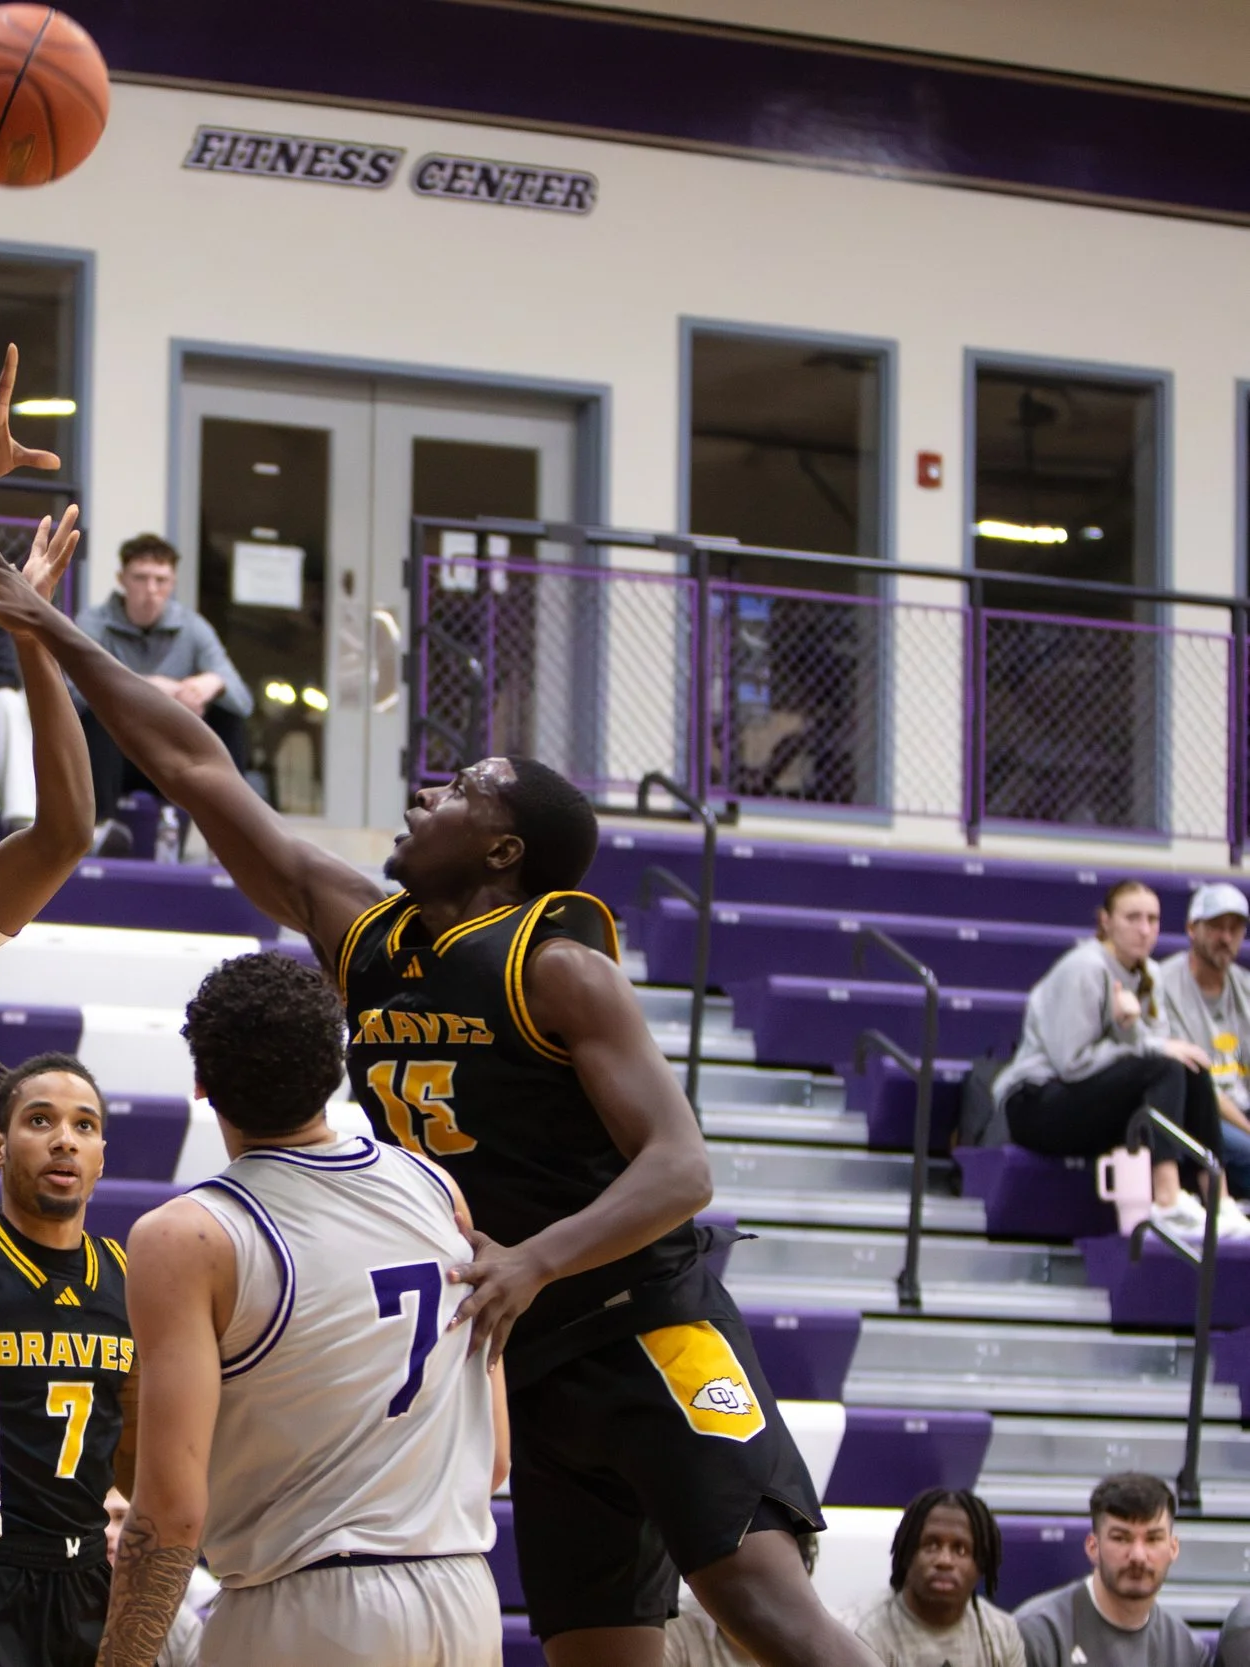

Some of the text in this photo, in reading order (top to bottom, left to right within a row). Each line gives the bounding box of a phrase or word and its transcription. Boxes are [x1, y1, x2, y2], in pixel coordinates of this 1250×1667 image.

[189, 131, 596, 212] FITNESS CENTER
[366, 1059, 479, 1157] 15
[365, 1257, 444, 1423] 7
[45, 1381, 95, 1479] 7
